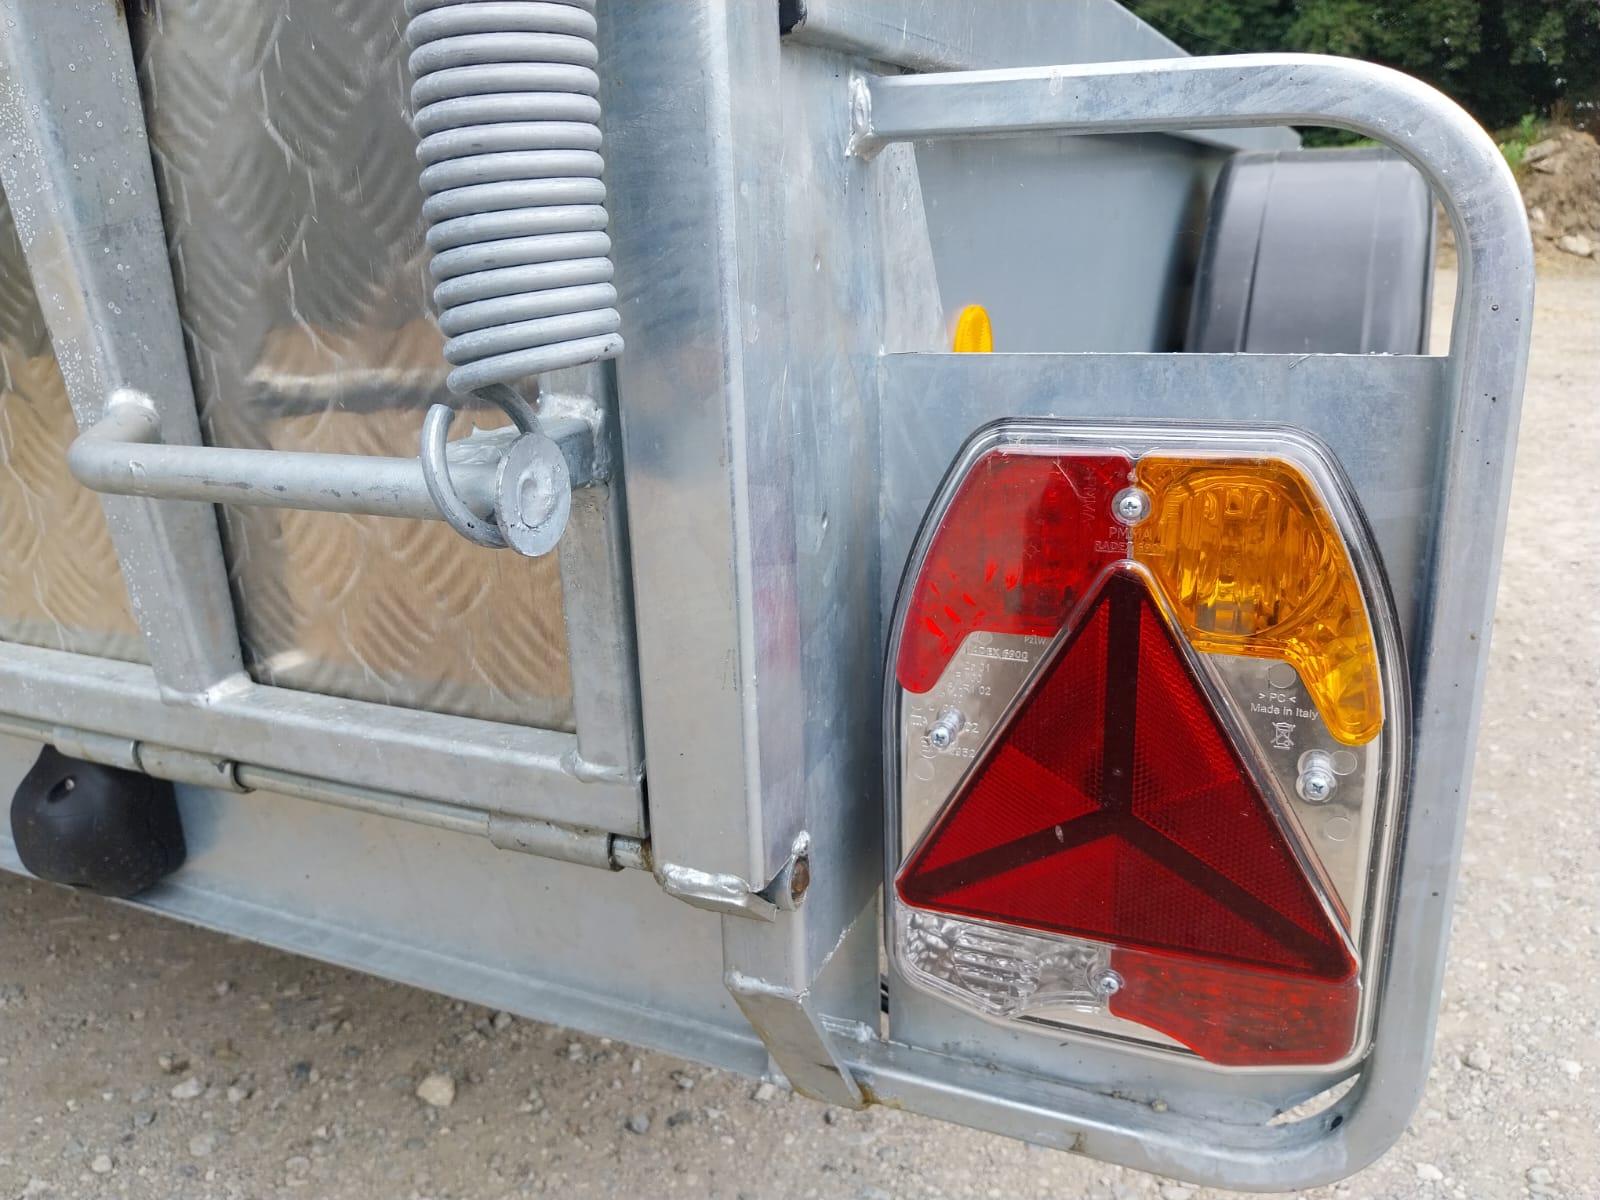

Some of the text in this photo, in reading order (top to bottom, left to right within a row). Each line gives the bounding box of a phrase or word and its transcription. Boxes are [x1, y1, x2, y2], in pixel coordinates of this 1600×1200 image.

[1094, 540, 1134, 551] RADE
[1250, 702, 1319, 721] Made in Italy
